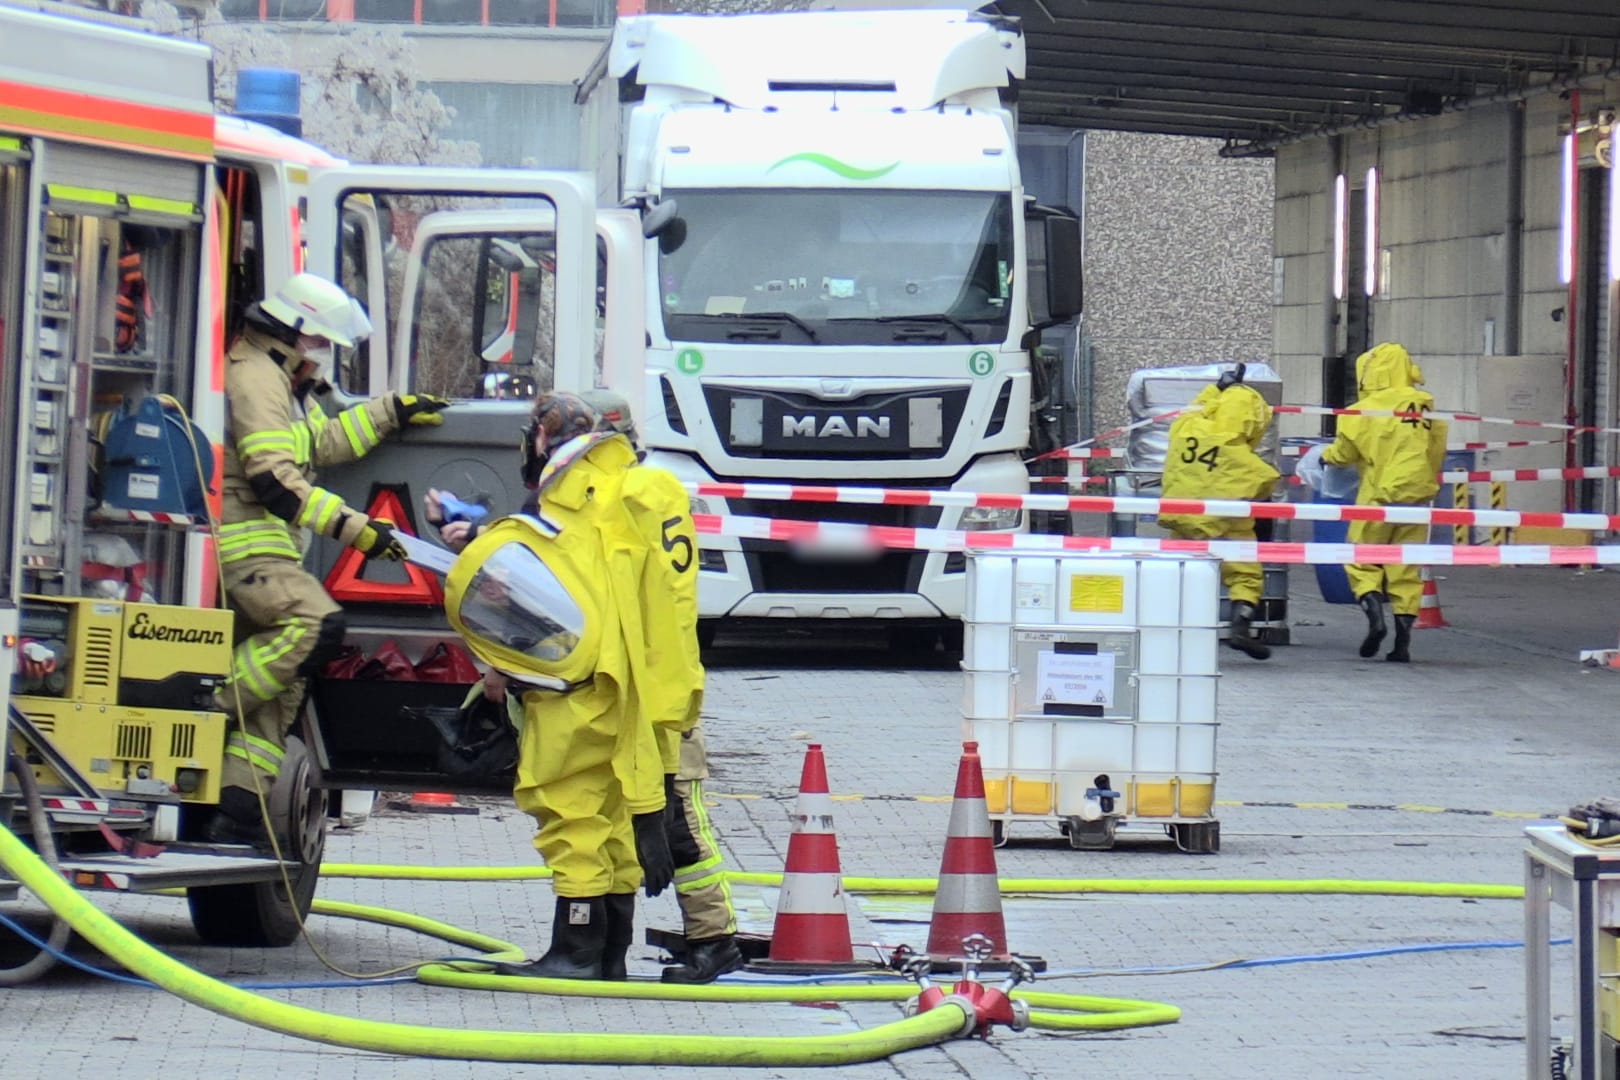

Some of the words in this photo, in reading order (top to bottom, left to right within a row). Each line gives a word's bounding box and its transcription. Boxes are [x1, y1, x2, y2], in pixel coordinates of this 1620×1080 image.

[974, 353, 990, 374] 6
[782, 415, 891, 438] MAN
[1181, 437, 1220, 472] 34
[662, 515, 692, 574] 5
[127, 612, 225, 645] Eisemann
